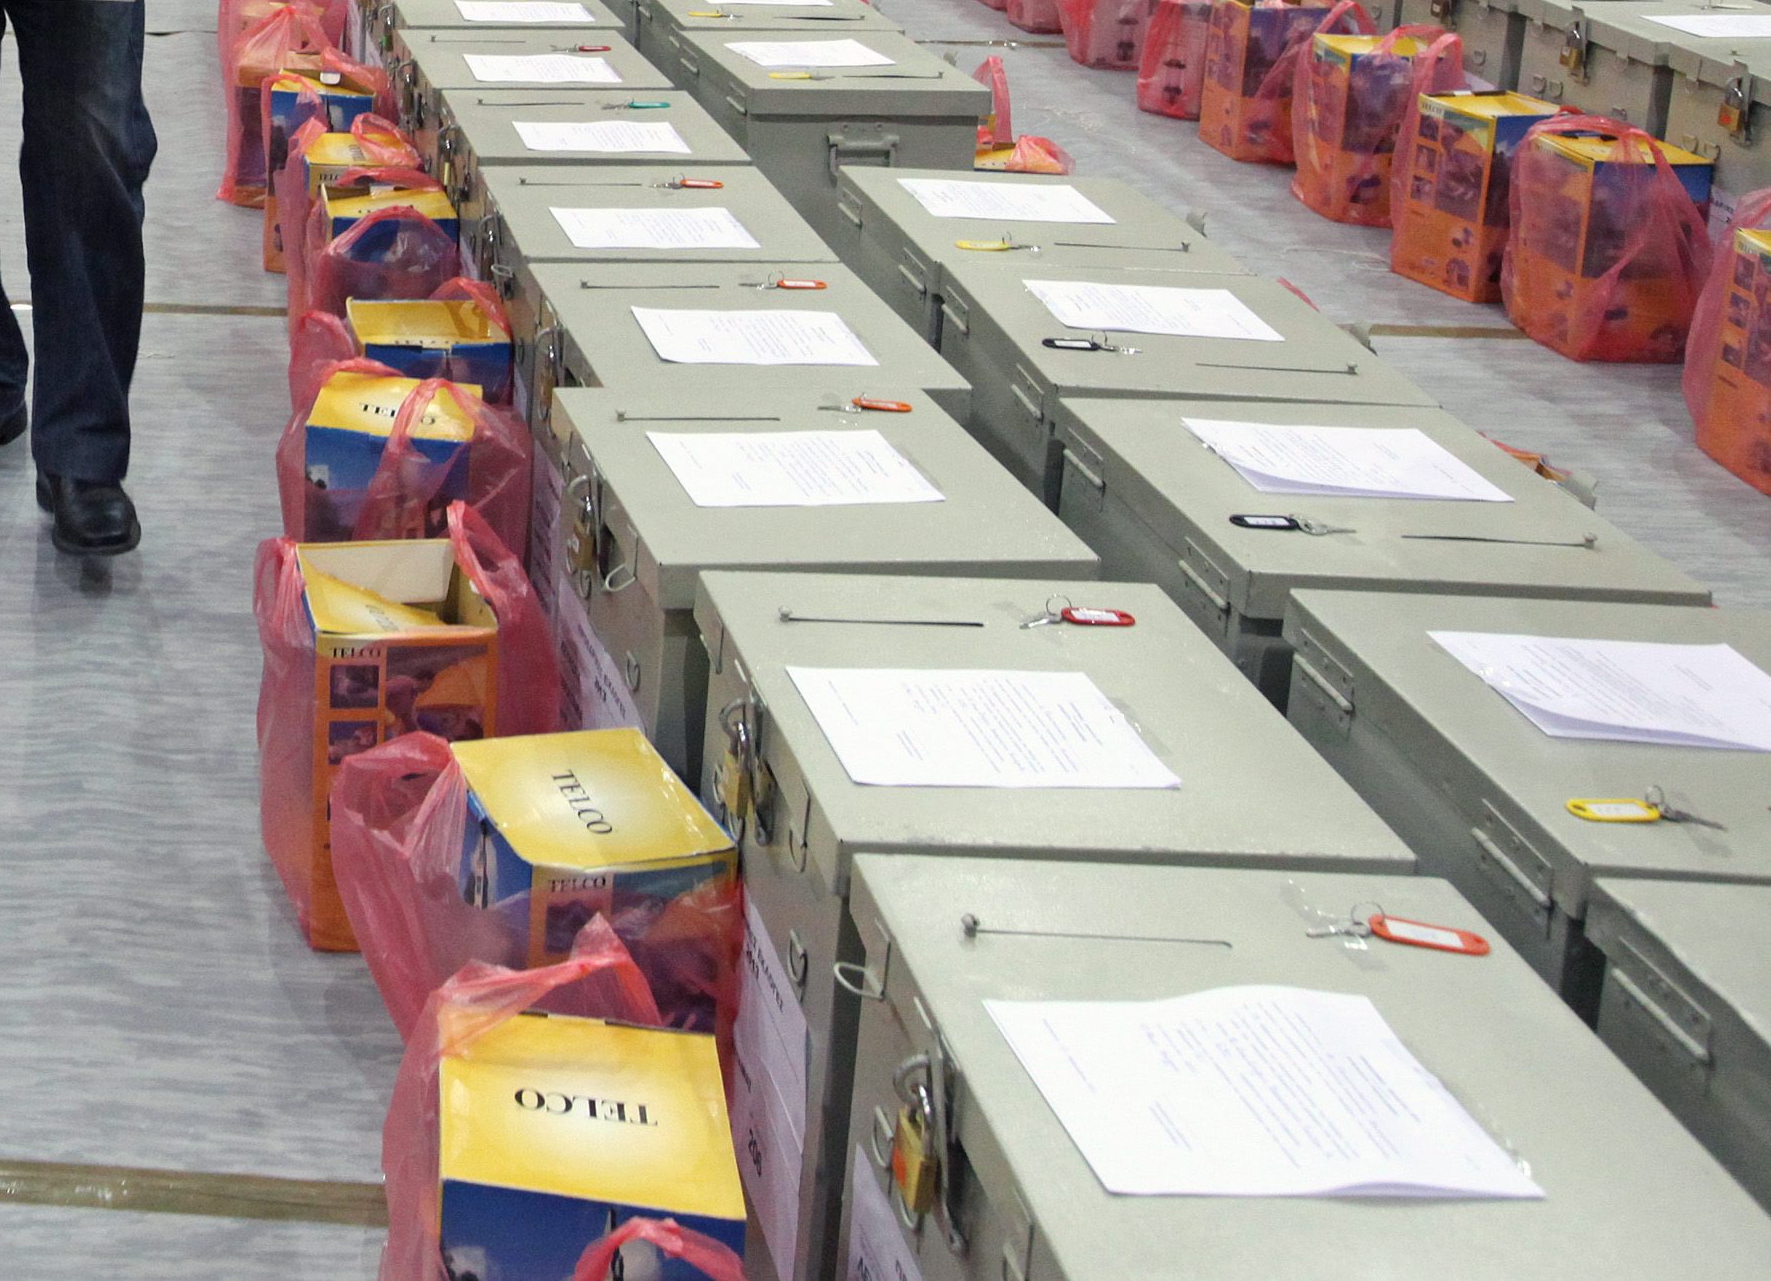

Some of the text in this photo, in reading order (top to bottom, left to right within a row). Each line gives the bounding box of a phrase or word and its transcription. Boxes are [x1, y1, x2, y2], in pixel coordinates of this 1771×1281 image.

[331, 647, 382, 658] TELCO
[551, 768, 614, 836] TELCO
[547, 876, 607, 893] TELCO
[514, 1086, 659, 1127] TELCO
